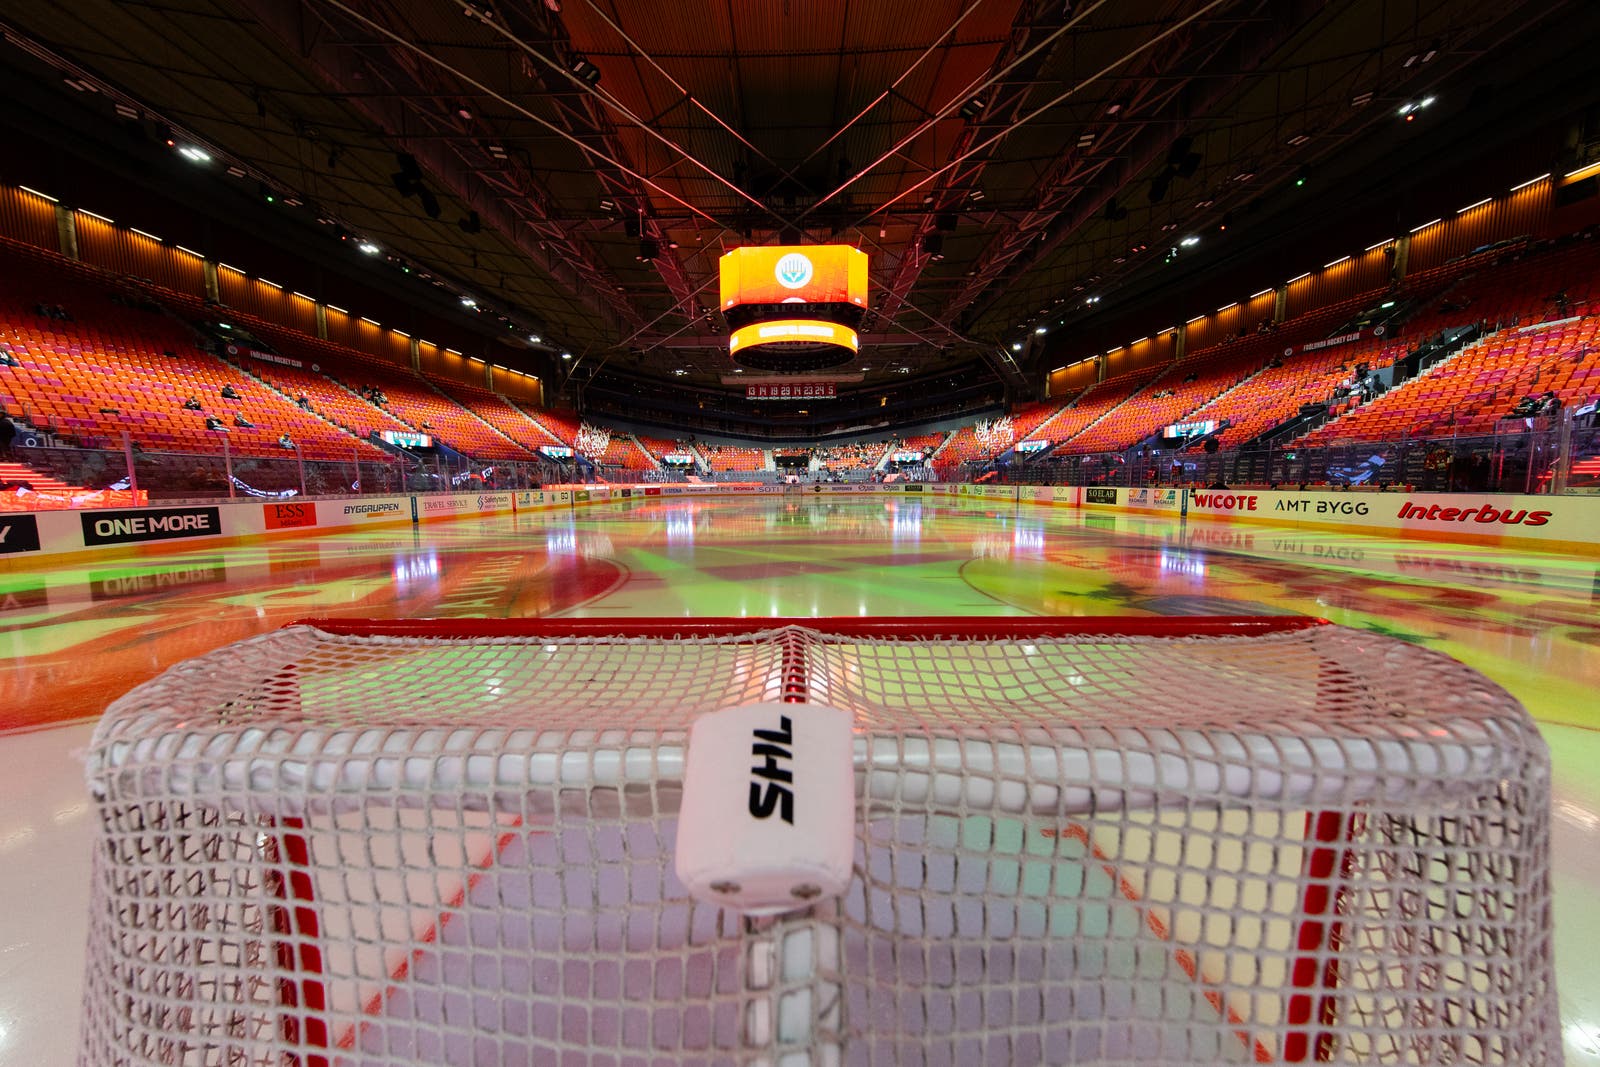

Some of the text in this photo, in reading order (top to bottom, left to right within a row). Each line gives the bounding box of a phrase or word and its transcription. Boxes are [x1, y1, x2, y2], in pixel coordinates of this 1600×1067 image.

[275, 504, 305, 519] ESS
[1194, 494, 1258, 511] WICOTE
[1275, 499, 1369, 516] AMT BYGG
[1397, 501, 1553, 526] Interbus
[94, 513, 210, 537] ONE MORE
[748, 714, 795, 826] SHL
